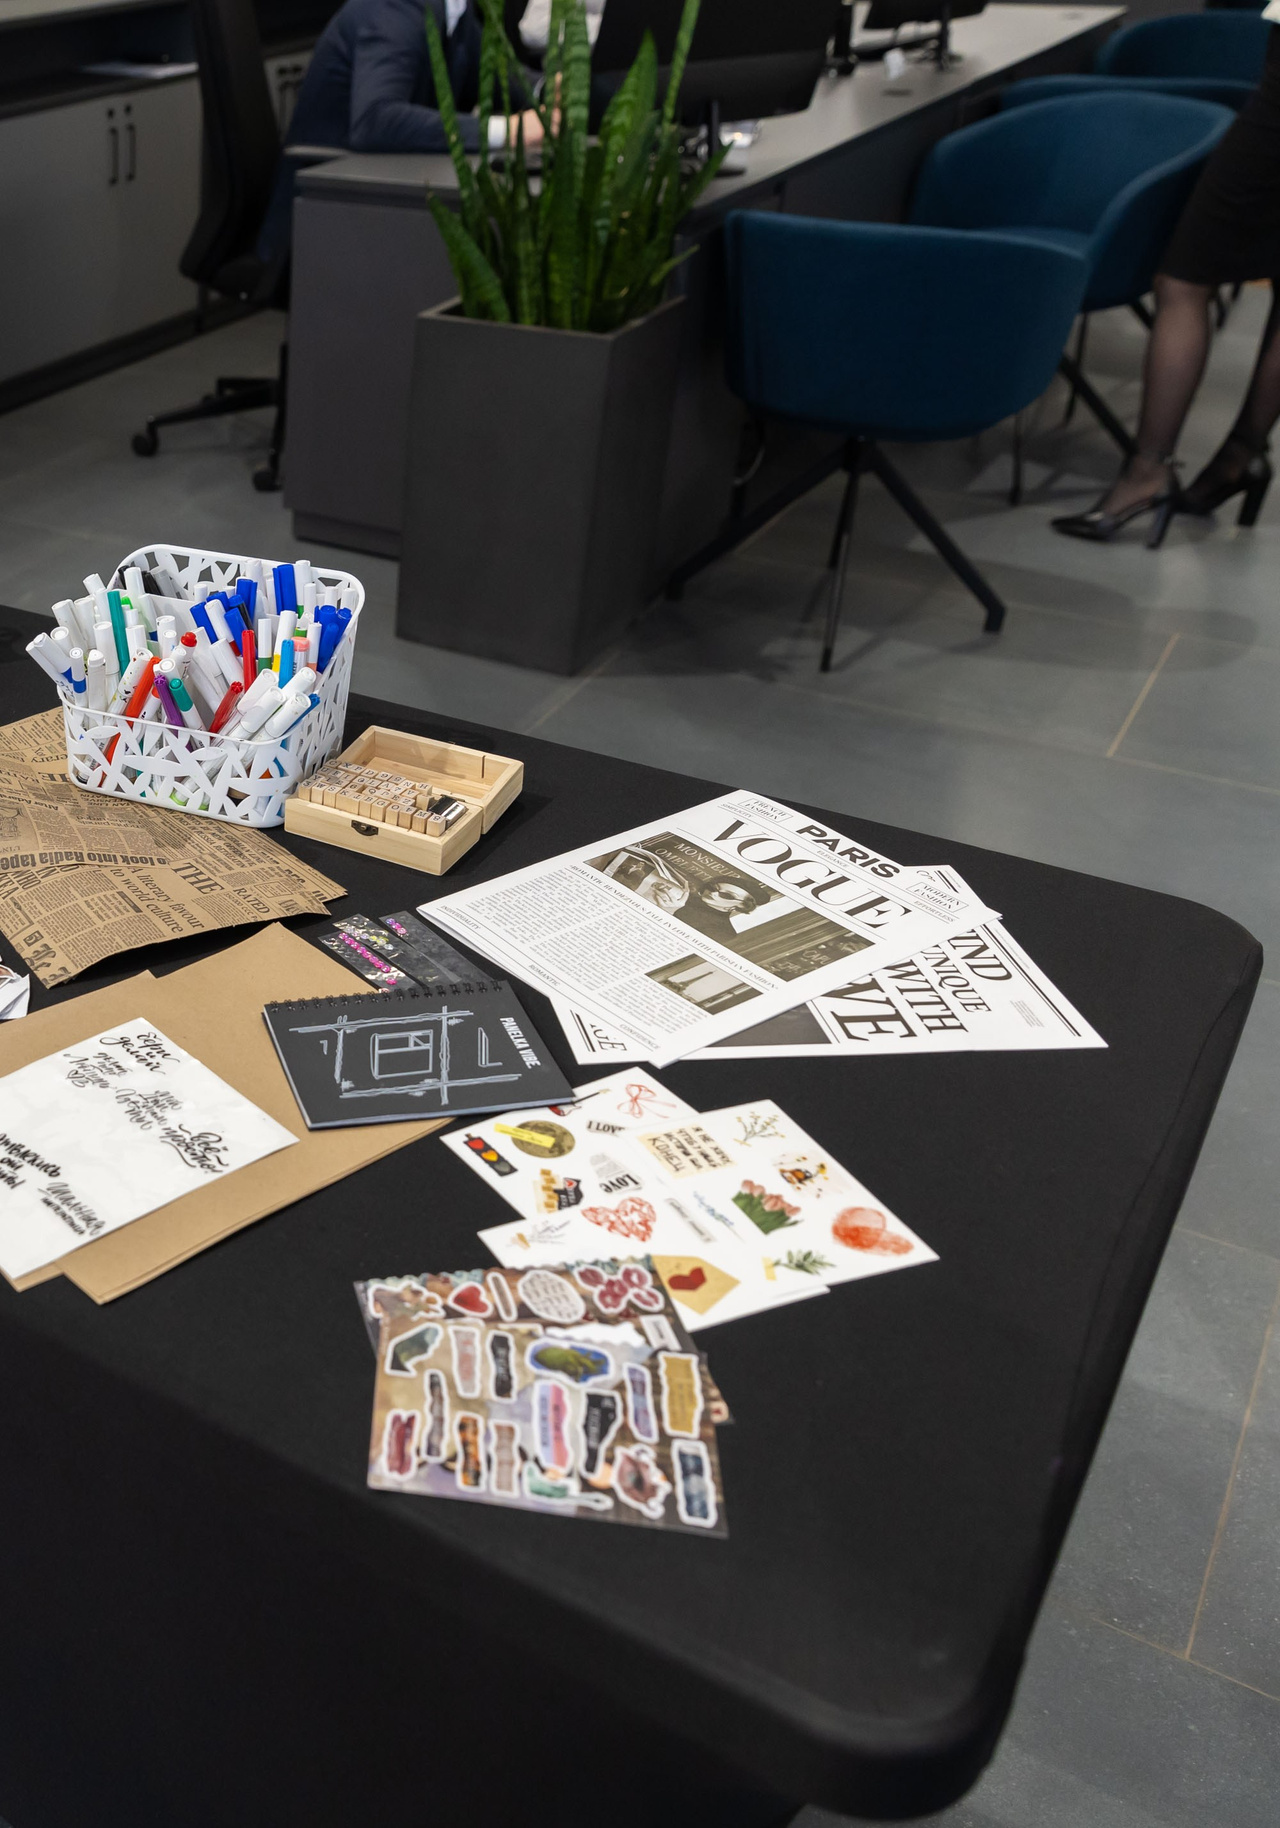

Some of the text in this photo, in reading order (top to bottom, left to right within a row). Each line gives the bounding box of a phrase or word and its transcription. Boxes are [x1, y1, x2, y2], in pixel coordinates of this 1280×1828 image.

[39, 851, 85, 865] Radia
[87, 852, 119, 866] into
[121, 854, 156, 866] look
[796, 824, 900, 878] PARIS
[172, 862, 225, 895] THE
[713, 819, 912, 928] VOGUE
[110, 868, 184, 934] to world culture
[136, 874, 174, 902] literary
[169, 902, 205, 929] favour
[233, 887, 271, 914] RATED
[441, 904, 481, 931] INDIVIDUALITY
[913, 900, 955, 922] EFFORTLESS
[947, 929, 1013, 981] IND
[528, 963, 561, 988] ROMANTIC
[920, 944, 992, 1013] UNIQUE
[820, 973, 918, 1042] VE
[882, 959, 969, 1033] WITH
[499, 1016, 542, 1069] PANELKA VIBE
[619, 1022, 661, 1050] CONFIDENCE
[648, 1136, 685, 1172] КОНЕЦ
